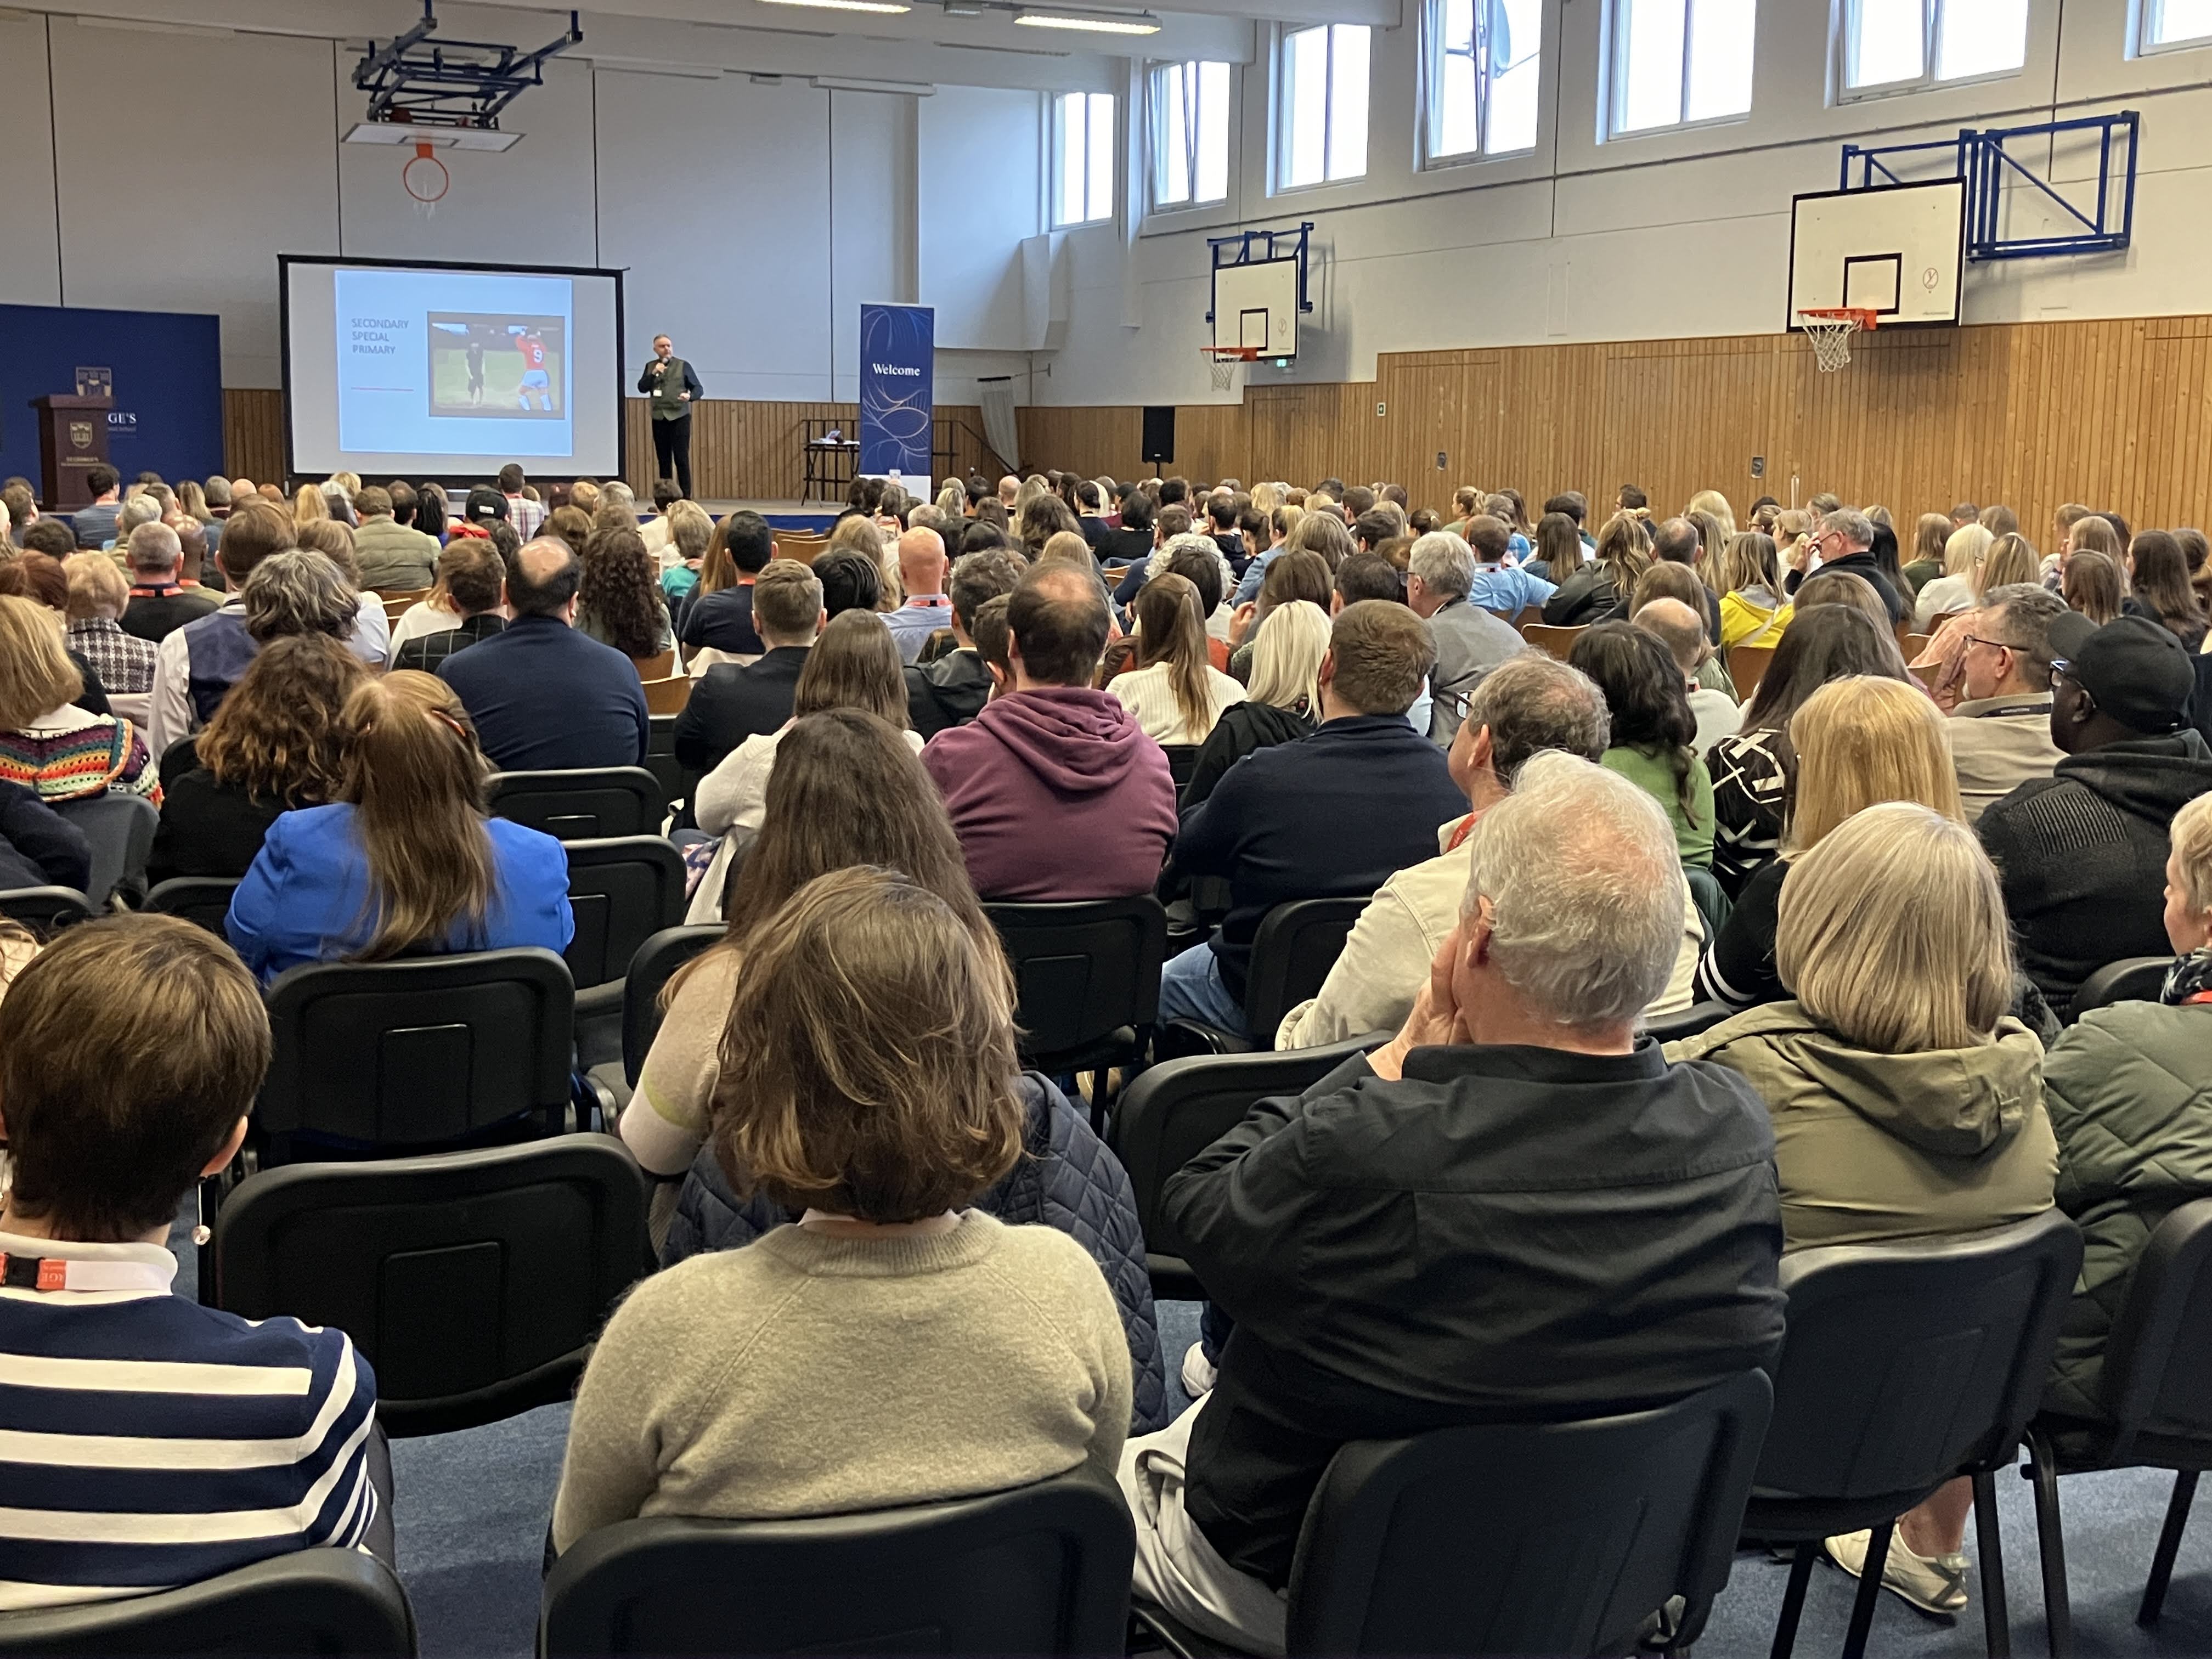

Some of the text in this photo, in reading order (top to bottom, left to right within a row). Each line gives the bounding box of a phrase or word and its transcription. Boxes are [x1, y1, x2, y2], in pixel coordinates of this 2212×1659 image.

[351, 318, 409, 329] SECONDARY
[352, 331, 390, 342] SPECIAL
[352, 345, 396, 355] PRIMARY
[533, 349, 543, 363] 9
[872, 363, 921, 376] Welcome
